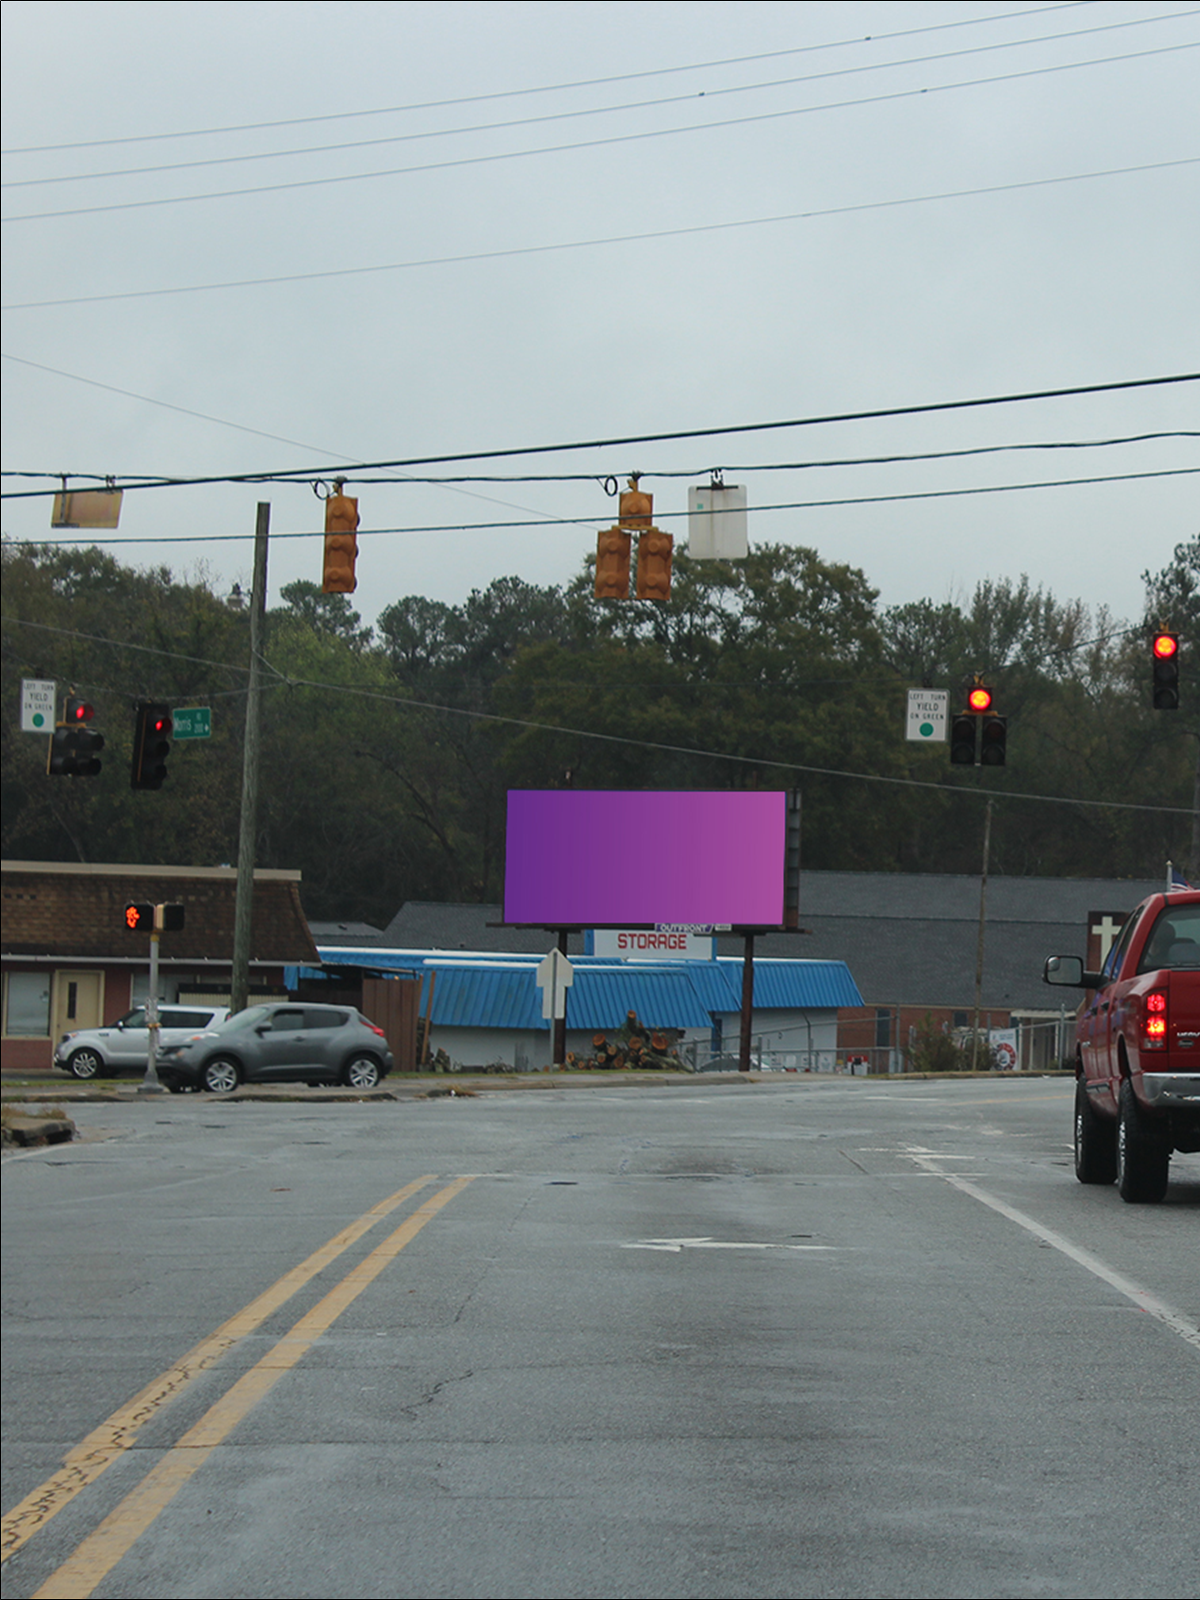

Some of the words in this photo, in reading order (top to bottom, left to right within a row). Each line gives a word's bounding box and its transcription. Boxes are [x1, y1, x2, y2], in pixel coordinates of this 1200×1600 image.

[30, 692, 48, 702] YIELD
[917, 702, 939, 711] YIELD
[923, 712, 944, 720] GREEN
[659, 923, 708, 933] OUTFRONT
[617, 933, 687, 949] STORAGE
